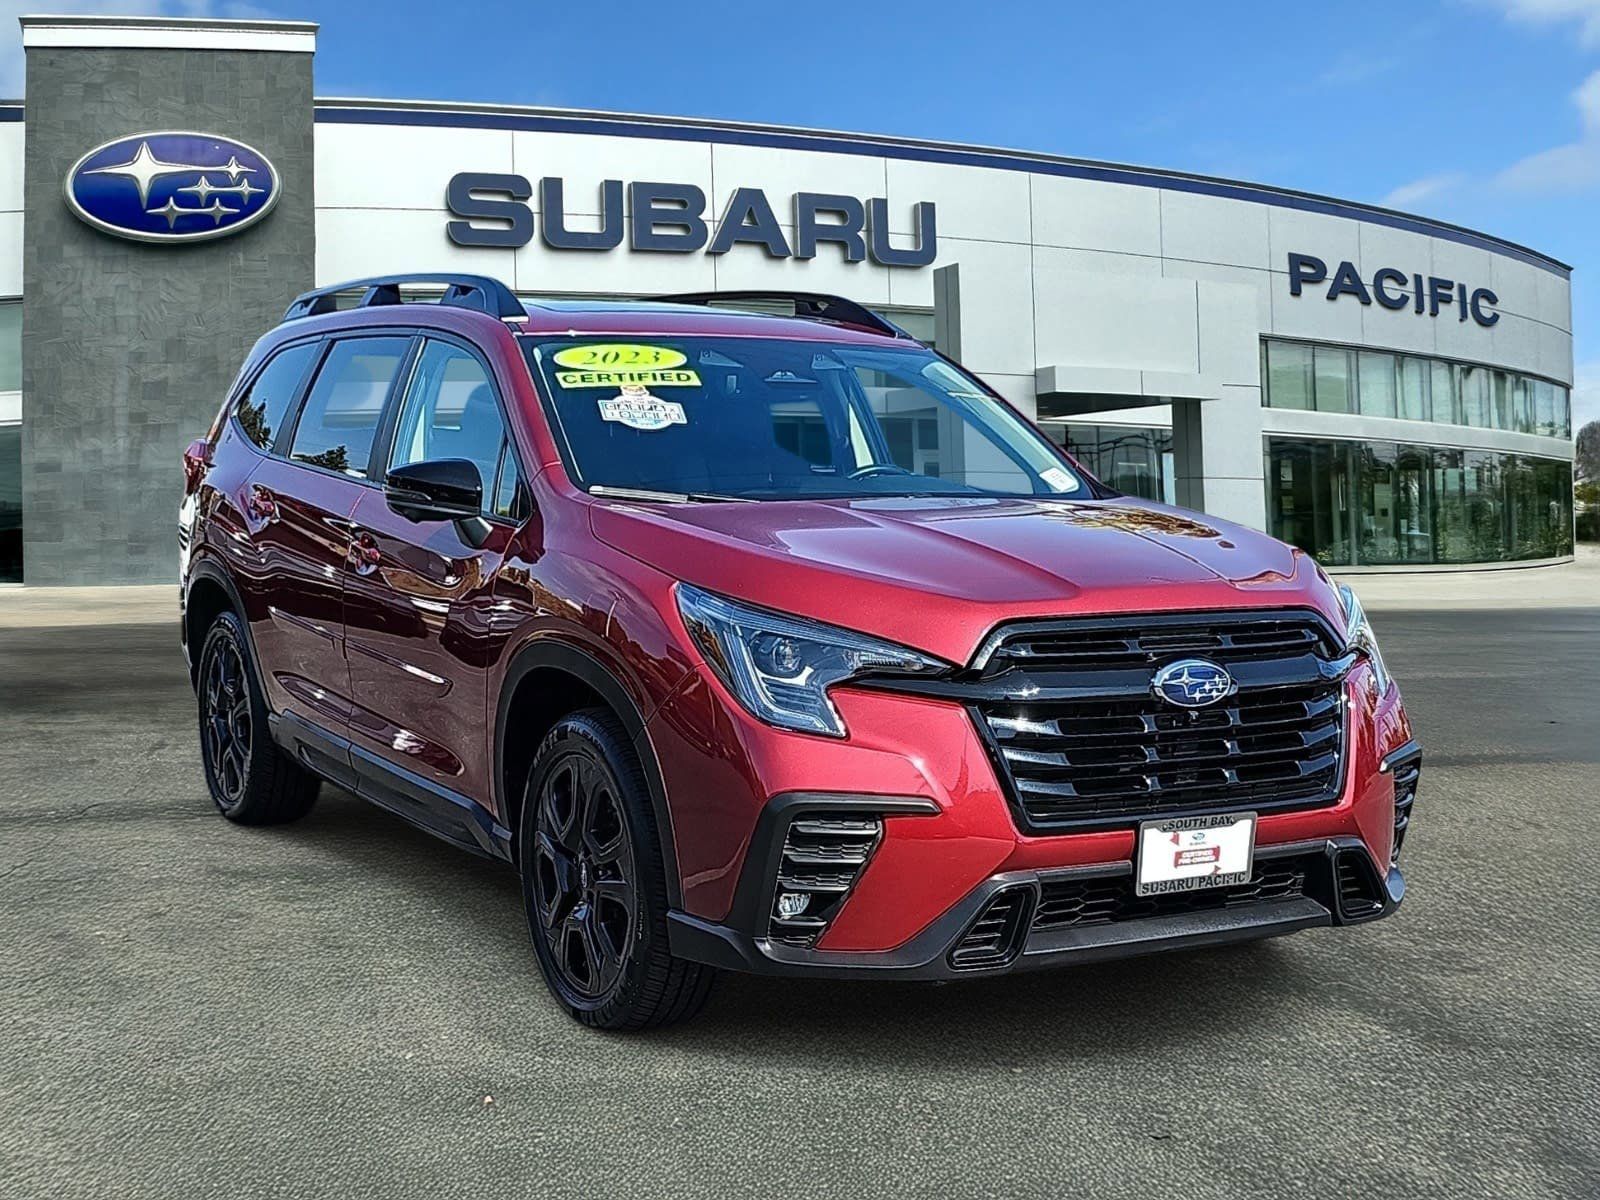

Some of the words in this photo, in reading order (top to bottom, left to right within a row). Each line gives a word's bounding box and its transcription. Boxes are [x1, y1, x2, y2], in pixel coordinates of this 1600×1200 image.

[447, 172, 937, 268] SUBARU
[1288, 252, 1500, 327] PACIFIC
[582, 351, 660, 364] 2023
[562, 373, 691, 384] CERTIFIED
[1168, 817, 1207, 830] SOUTH
[1211, 815, 1232, 826] BAY
[1141, 879, 1194, 894] SUBARU
[1198, 872, 1246, 888] PACIFIC
